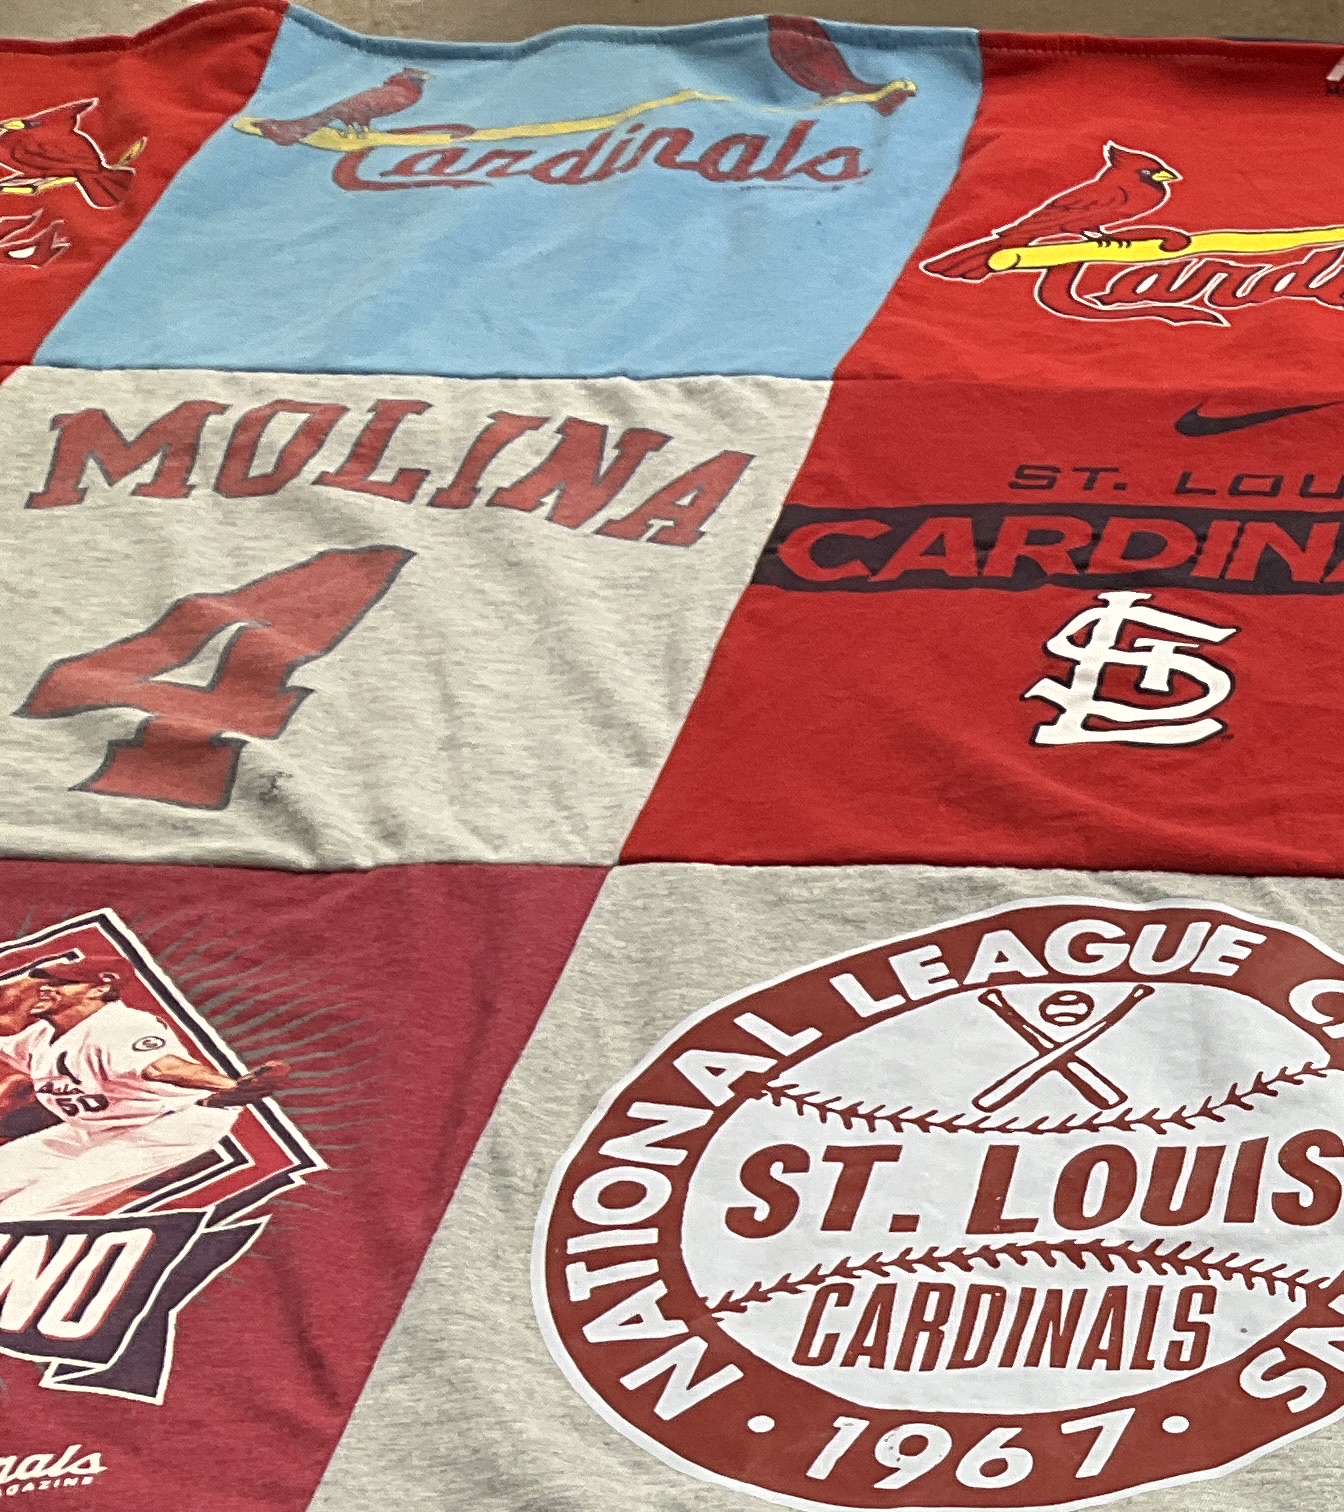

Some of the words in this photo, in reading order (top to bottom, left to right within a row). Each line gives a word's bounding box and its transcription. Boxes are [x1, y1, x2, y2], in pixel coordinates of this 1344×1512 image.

[332, 120, 873, 191] Cardinals
[25, 398, 755, 548] MOLINA
[1006, 463, 1128, 493] ST.
[12, 544, 416, 810] 4
[567, 1011, 823, 1421] NATIONAL
[829, 918, 1268, 1018] LEAGUE
[725, 1143, 920, 1240] ST.
[0, 1226, 156, 1342] NO
[794, 1280, 1218, 1372] CARDINALS
[806, 1407, 1137, 1490] 1967
